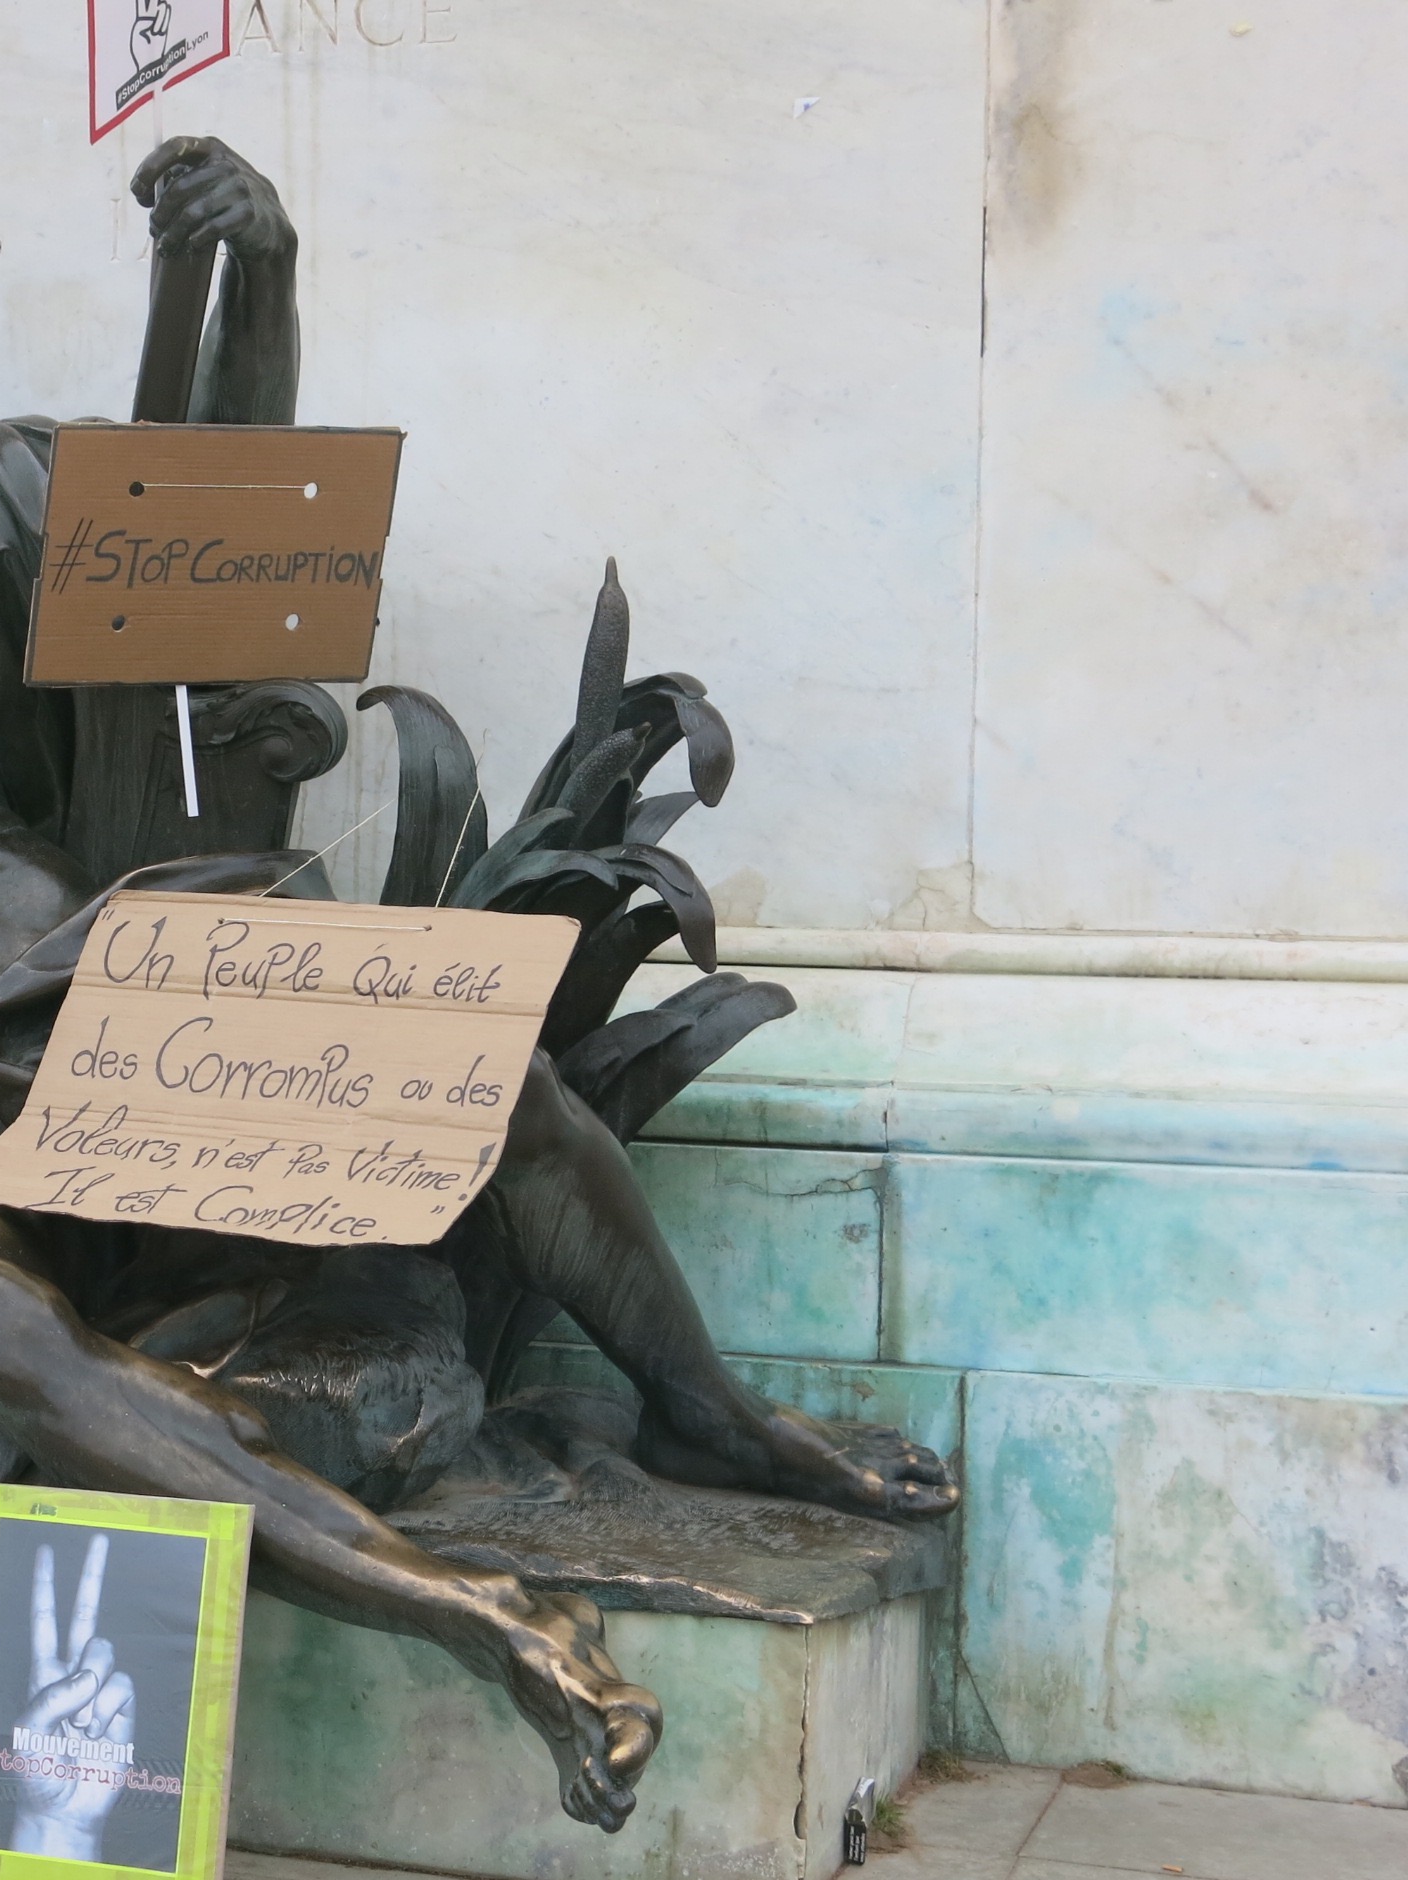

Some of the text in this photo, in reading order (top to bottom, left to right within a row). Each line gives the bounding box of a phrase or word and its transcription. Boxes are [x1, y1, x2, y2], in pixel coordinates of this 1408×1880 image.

[232, 0, 459, 56] ANCE
[117, 31, 209, 105] #StopCorruption Lyon
[433, 962, 503, 1004] élit
[71, 1015, 138, 1080] des
[400, 1076, 434, 1101] ou
[446, 1055, 502, 1108] des
[191, 1138, 286, 1172] n'est
[24, 1166, 116, 1209] Il
[114, 1182, 187, 1214] est
[12, 1725, 135, 1765] Mouvement
